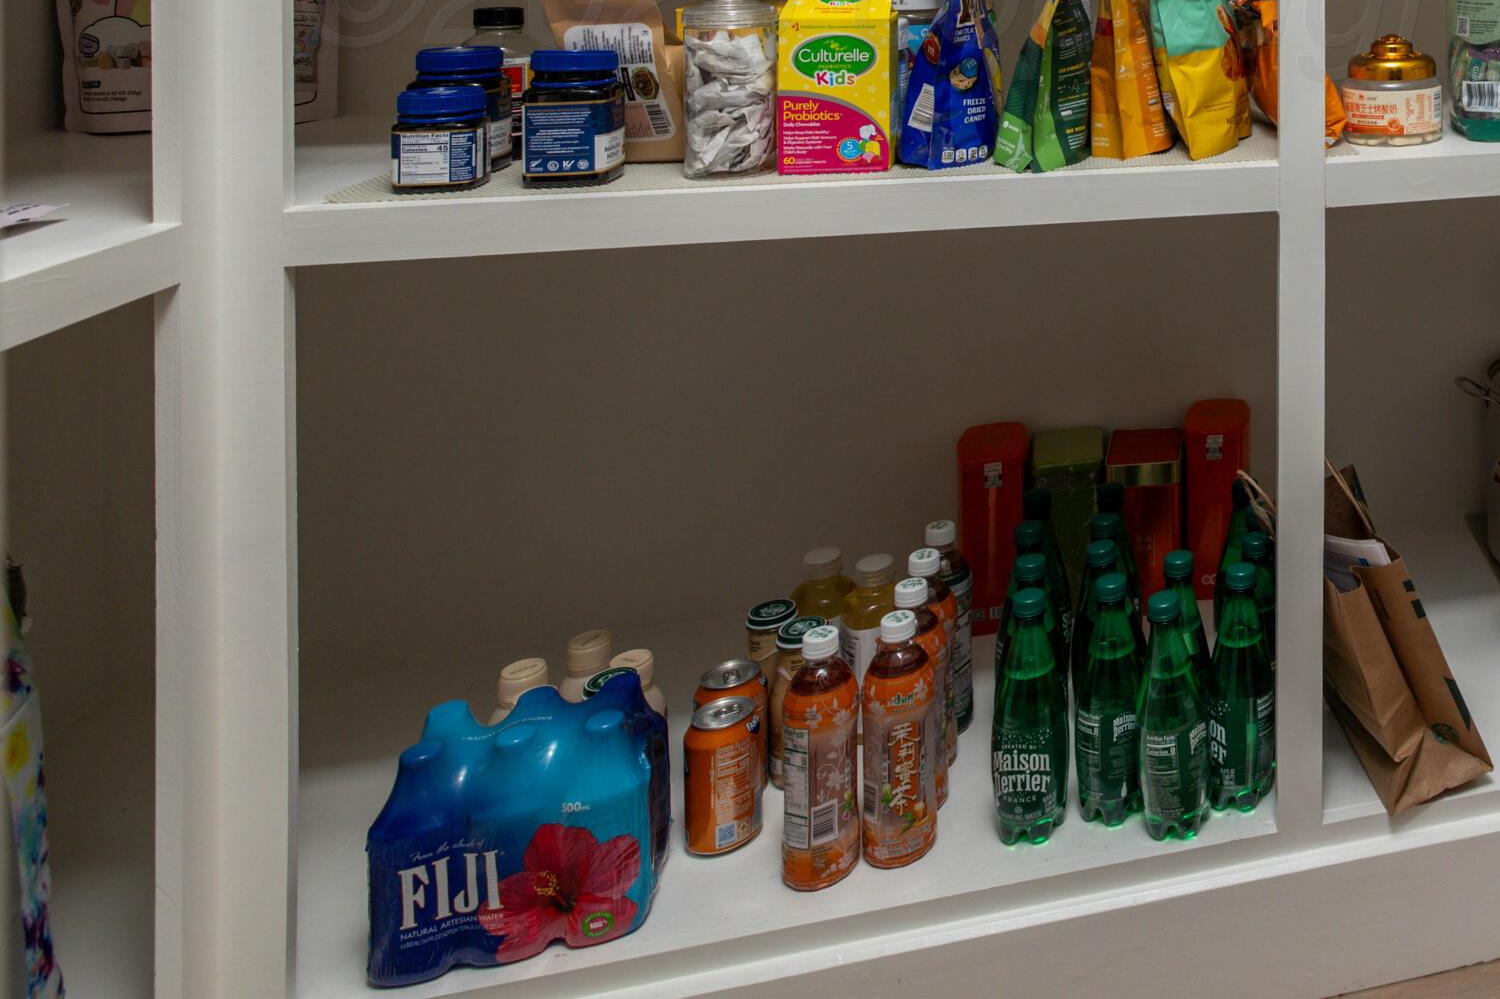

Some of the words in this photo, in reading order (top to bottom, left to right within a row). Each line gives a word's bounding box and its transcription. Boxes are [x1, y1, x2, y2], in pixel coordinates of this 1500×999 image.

[798, 48, 871, 63] Culturelle
[815, 70, 856, 86] Kids
[783, 100, 819, 112] Purely
[963, 98, 987, 107] FREEZE
[783, 111, 841, 121] Probiotics
[967, 106, 987, 116] DRIED
[964, 114, 987, 124] CANDY
[436, 144, 449, 152] 45
[846, 141, 853, 150] 5
[783, 157, 795, 165] 60
[992, 750, 1051, 772] Maison
[397, 849, 505, 932] FIJI
[400, 925, 438, 941] NATURAL
[440, 914, 477, 931] ARTESIAN
